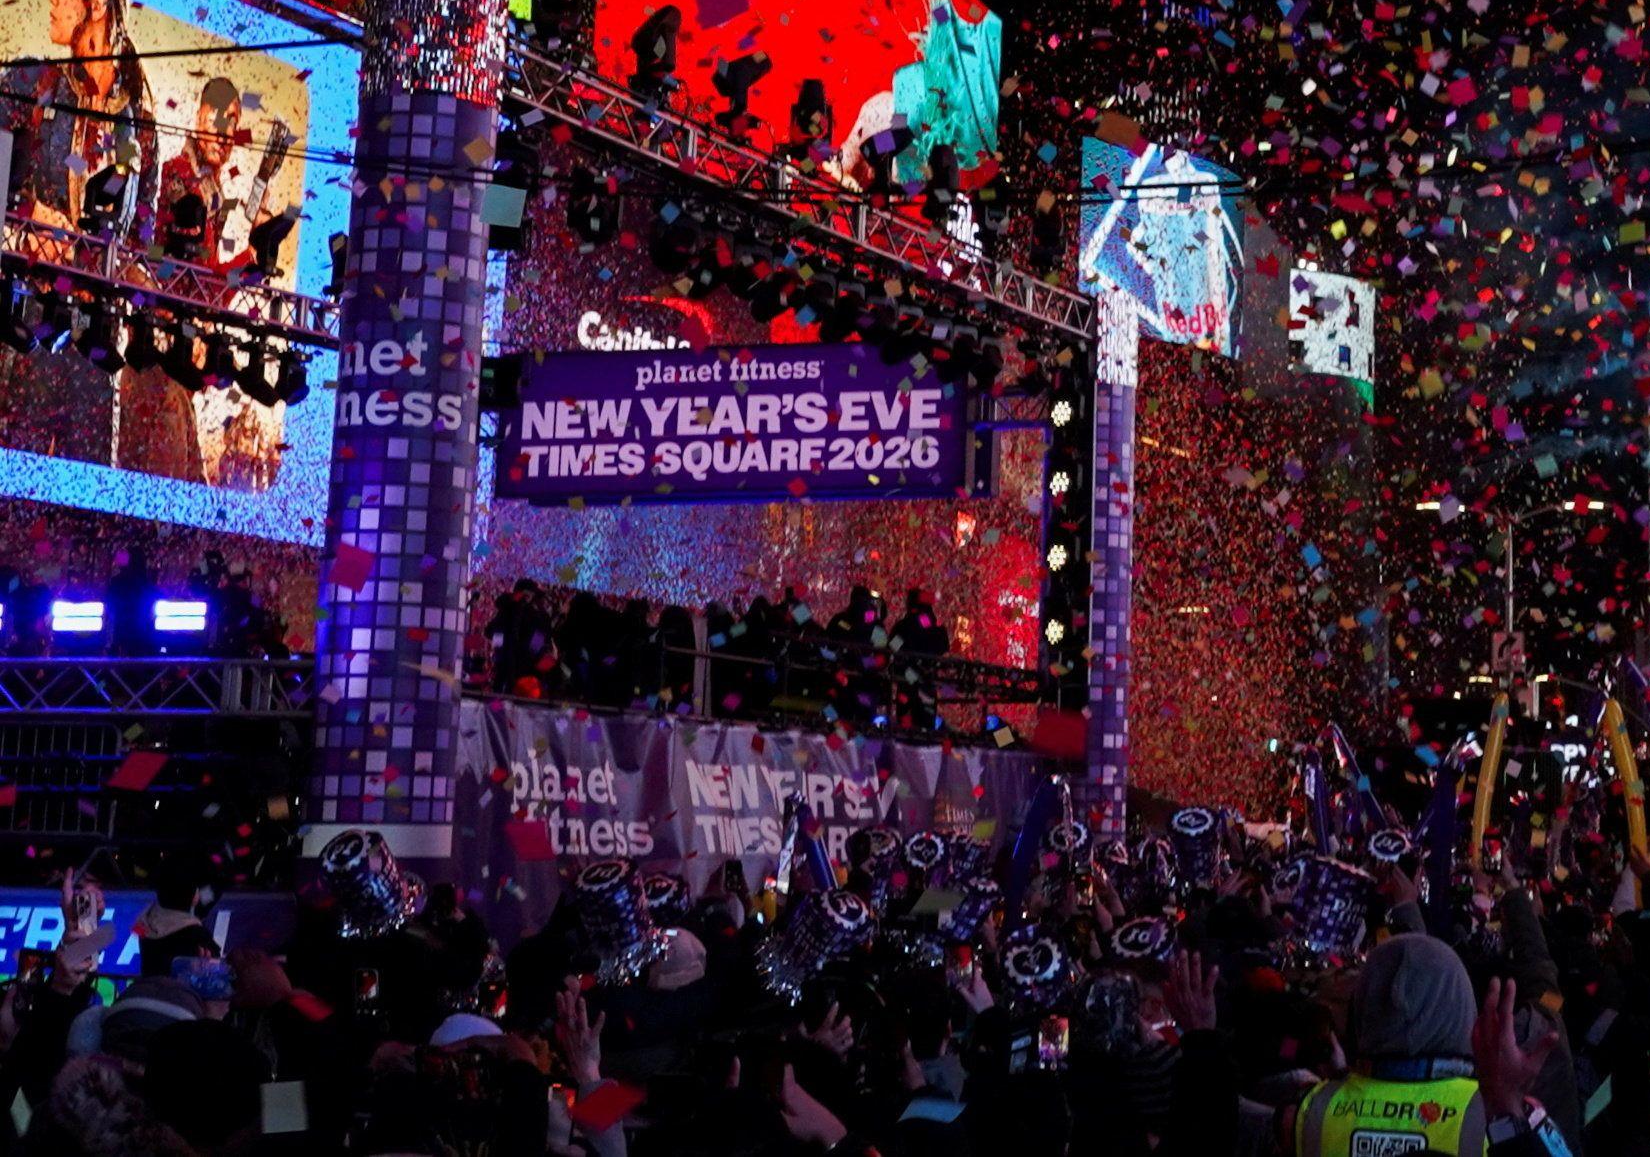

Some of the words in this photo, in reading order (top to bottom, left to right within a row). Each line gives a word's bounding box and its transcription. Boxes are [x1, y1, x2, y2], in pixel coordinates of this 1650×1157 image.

[635, 358, 722, 390] planet
[728, 357, 821, 383] fitness
[521, 398, 632, 440] NEW
[640, 392, 828, 437] YEAR'S
[837, 388, 942, 430] EVE
[519, 444, 646, 478] TIMES
[827, 435, 940, 472] 2026
[510, 748, 620, 815] planet
[685, 758, 761, 812] NEW
[694, 814, 784, 858] TIMES
